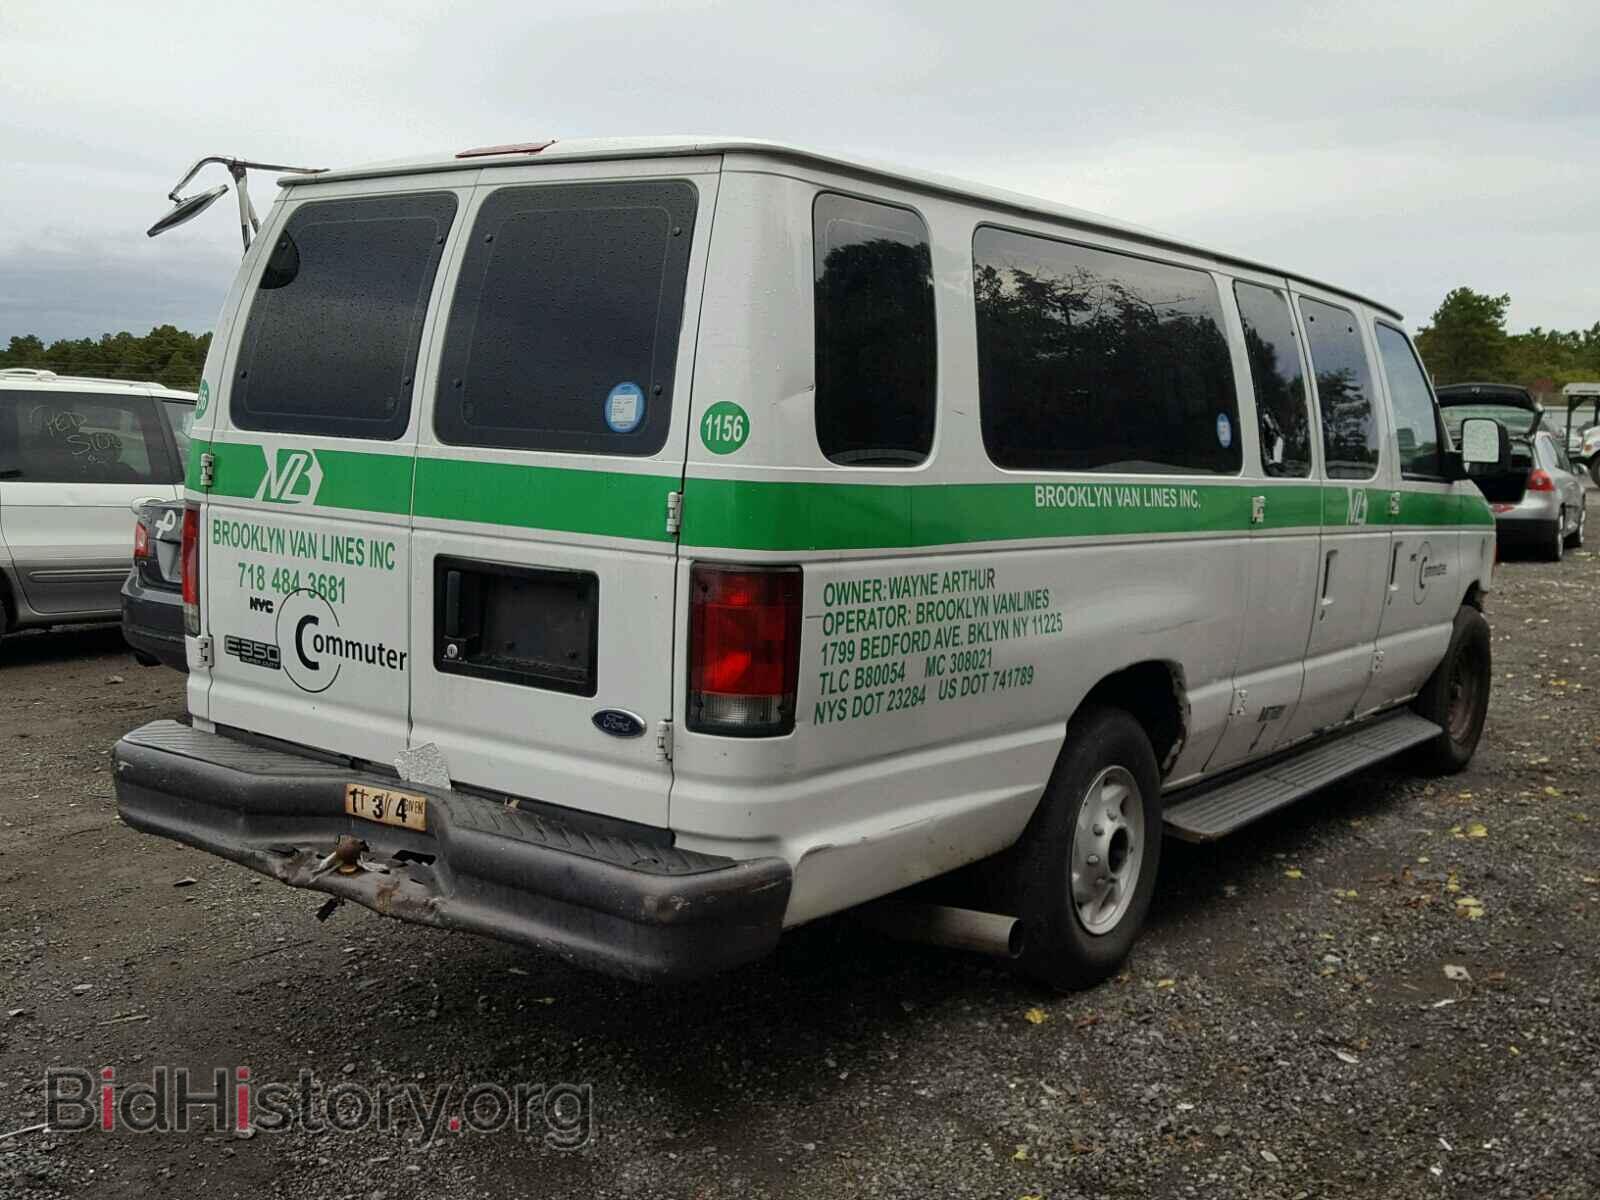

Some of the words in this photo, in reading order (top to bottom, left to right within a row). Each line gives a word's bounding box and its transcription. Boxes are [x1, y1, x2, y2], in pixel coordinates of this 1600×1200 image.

[705, 414, 744, 442] 1156
[1035, 485, 1112, 508] BROOKLYN
[1115, 487, 1140, 508] VAN
[1144, 488, 1177, 508] LINES
[1180, 489, 1201, 509] INC.
[213, 519, 285, 553] BROOKLYN
[290, 530, 318, 560] VAN
[322, 535, 365, 566] LINES
[369, 540, 396, 570] INC
[238, 562, 265, 591] 718
[271, 568, 300, 597] 484
[307, 572, 346, 604] 3681
[942, 568, 996, 594] ARTHUR
[249, 597, 274, 613] NYC
[822, 605, 911, 636] OPERATOR:
[916, 596, 989, 625] BROOKLYN
[992, 588, 1050, 614] VANLINES
[295, 614, 408, 671] Commuter
[821, 640, 855, 666] 1799
[860, 629, 931, 661] BEDFORD
[934, 626, 964, 650] AVE.
[968, 618, 1009, 645] BKLYN
[1013, 616, 1029, 639] NY
[1032, 612, 1063, 635] 11225
[820, 667, 849, 696] TLC
[854, 661, 906, 690] B80054
[924, 654, 946, 678] MC
[949, 647, 993, 674] 308021
[813, 699, 848, 726] NYS
[851, 692, 884, 719] DOT
[886, 686, 926, 712] 23284
[939, 678, 957, 701] US
[961, 673, 989, 697] DOT
[992, 665, 1035, 691] 741789
[603, 713, 632, 731] Ford
